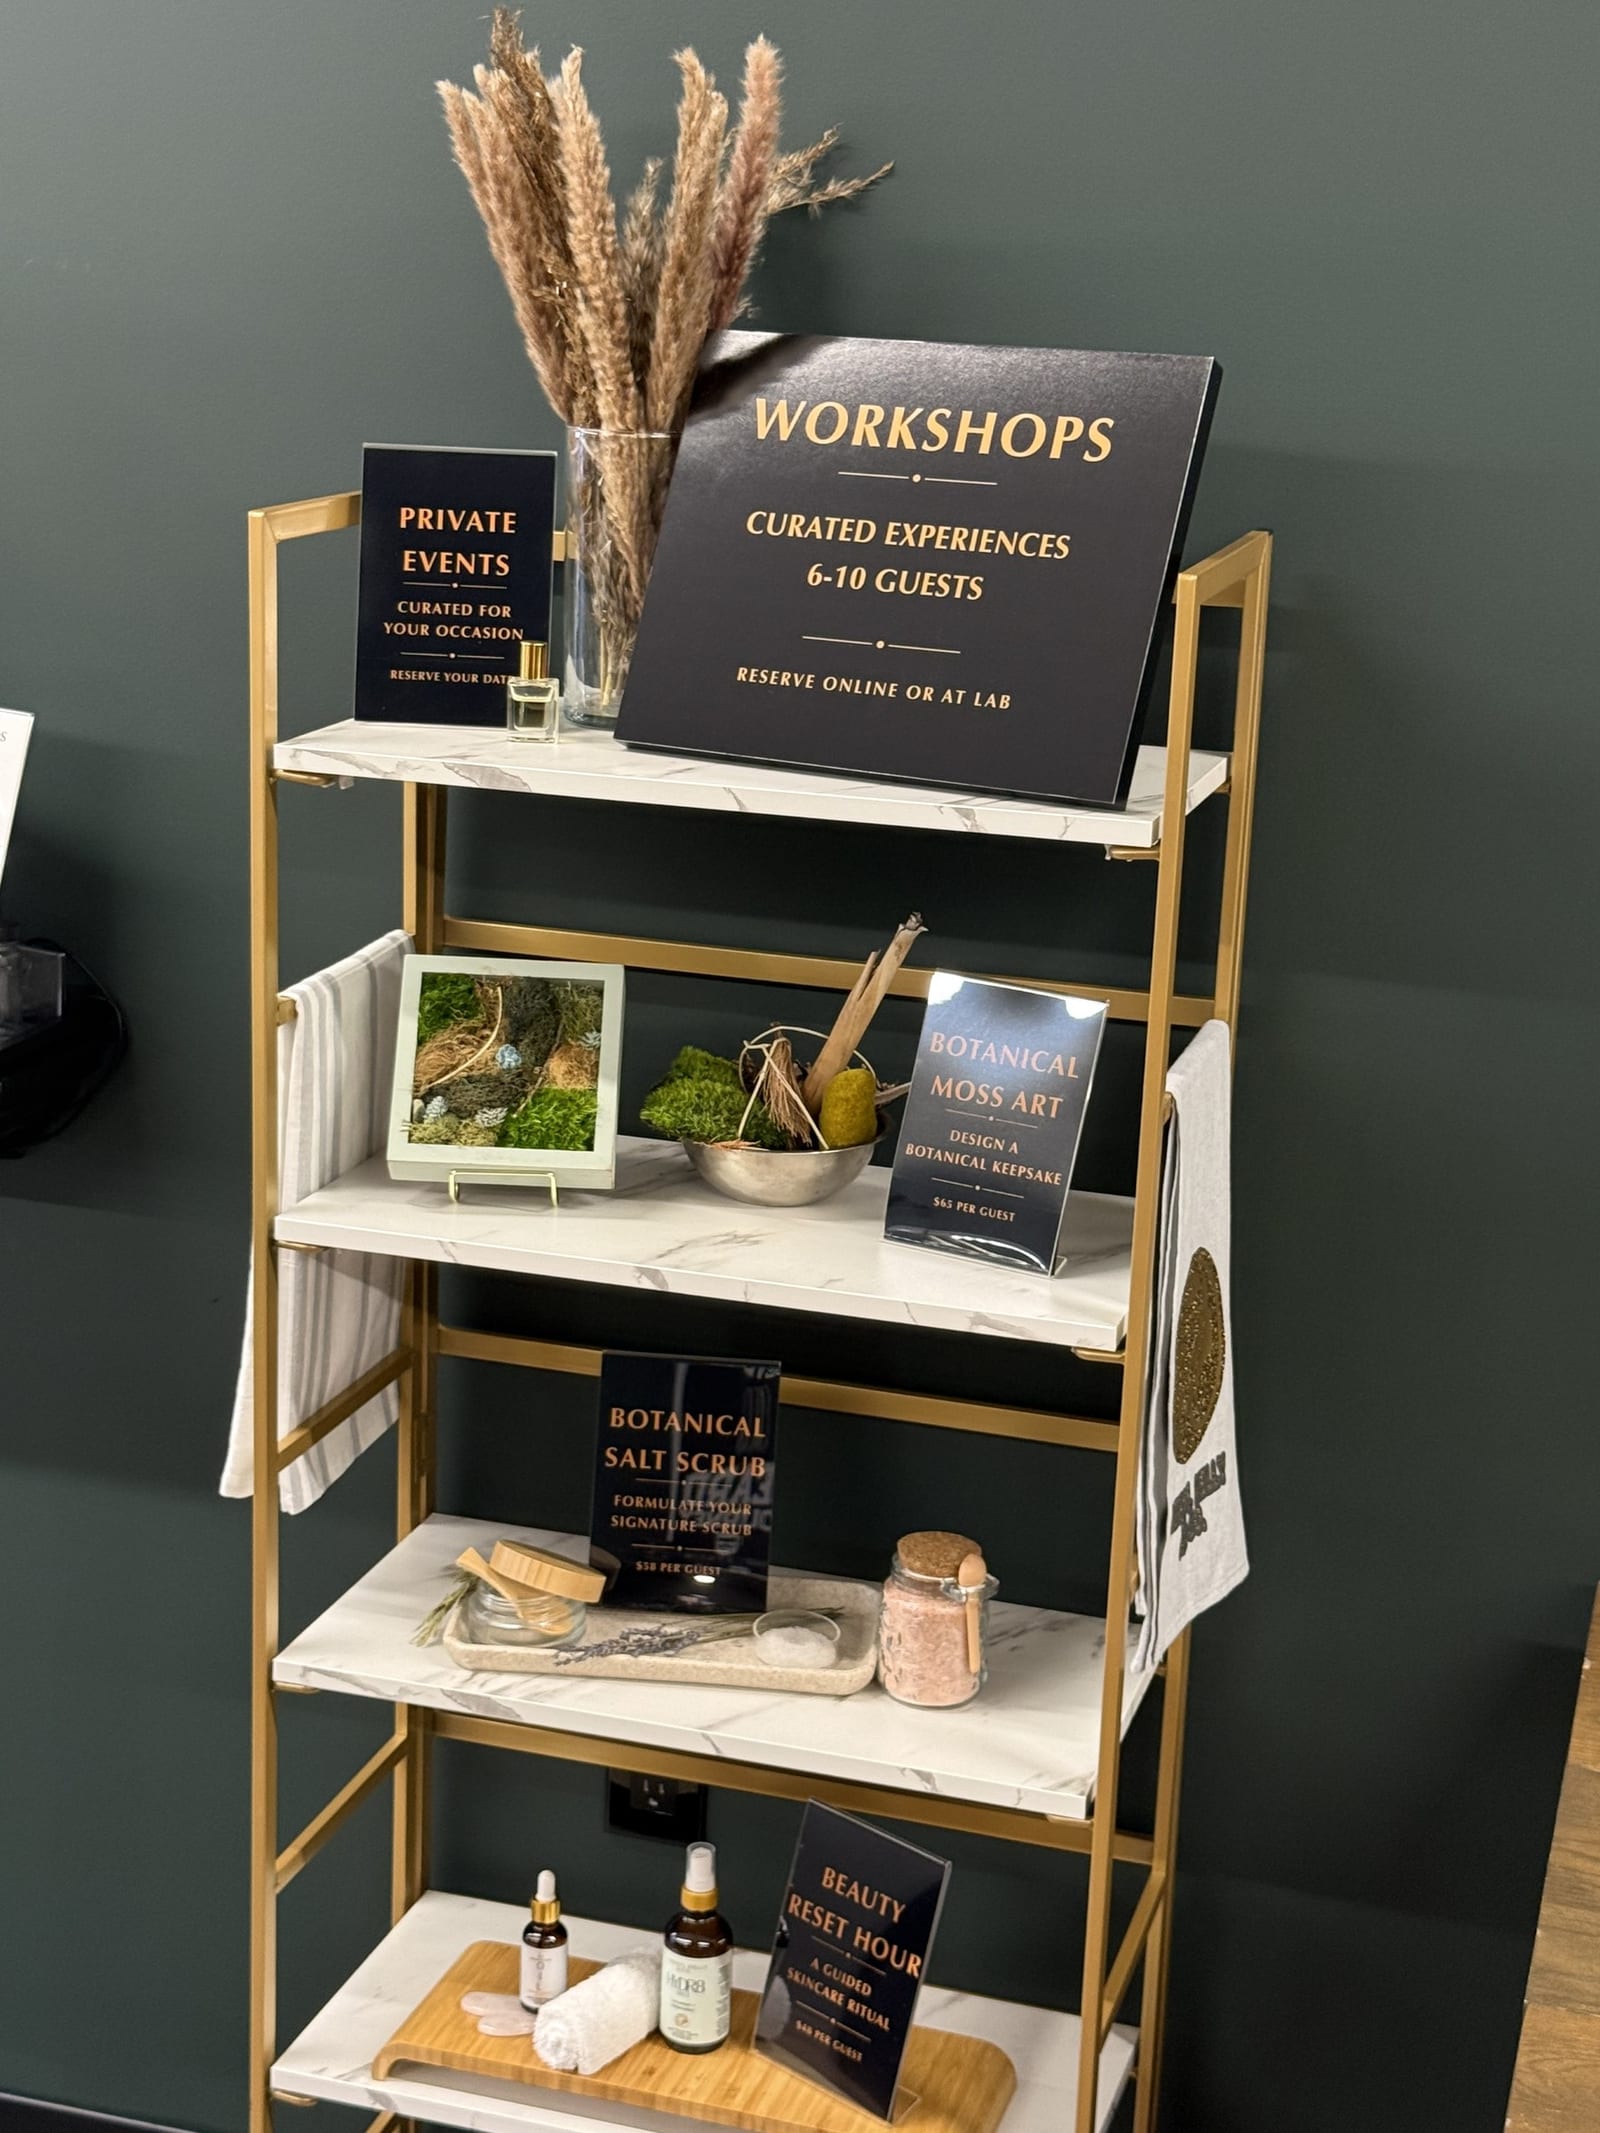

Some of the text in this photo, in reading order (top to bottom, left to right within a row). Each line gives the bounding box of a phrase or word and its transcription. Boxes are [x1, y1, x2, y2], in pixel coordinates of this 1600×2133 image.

[755, 397, 1114, 462] WORKSHOPS
[400, 507, 517, 534] PRIVATE
[746, 510, 1071, 560] CURATED EXPERIENCES
[403, 550, 510, 576] EVENTS
[807, 563, 984, 601] 6-10 GUESTS
[397, 600, 511, 618] CURATED FOR
[383, 622, 523, 640] YOUR OCCASION
[390, 669, 440, 682] RESERVE
[443, 672, 479, 683] YOUR
[736, 667, 1011, 709] RESERVE ONLINE OR AT LAB
[930, 1032, 1078, 1079] BOTANICAL
[931, 1075, 1063, 1119] MOSS ART
[950, 1130, 1019, 1155] DESIGN A
[905, 1144, 1062, 1186] BOTANICAL KEEPSAKE
[933, 1196, 1016, 1222] $65 PER GUEST
[610, 1407, 766, 1438] BOTANICAL
[605, 1446, 765, 1477] SALT SCRUB
[614, 1495, 751, 1515] FORMULATE YOUR
[611, 1515, 752, 1536] SIGNATURE SCRUB
[659, 1562, 681, 1573] PER
[685, 1564, 720, 1575] GUEST
[821, 1866, 906, 1924] BEAUTY
[788, 1893, 922, 1979] RESET HOUR
[810, 1957, 873, 1997] A GUIDED
[786, 1967, 890, 2032] SKINCARE RITUAL
